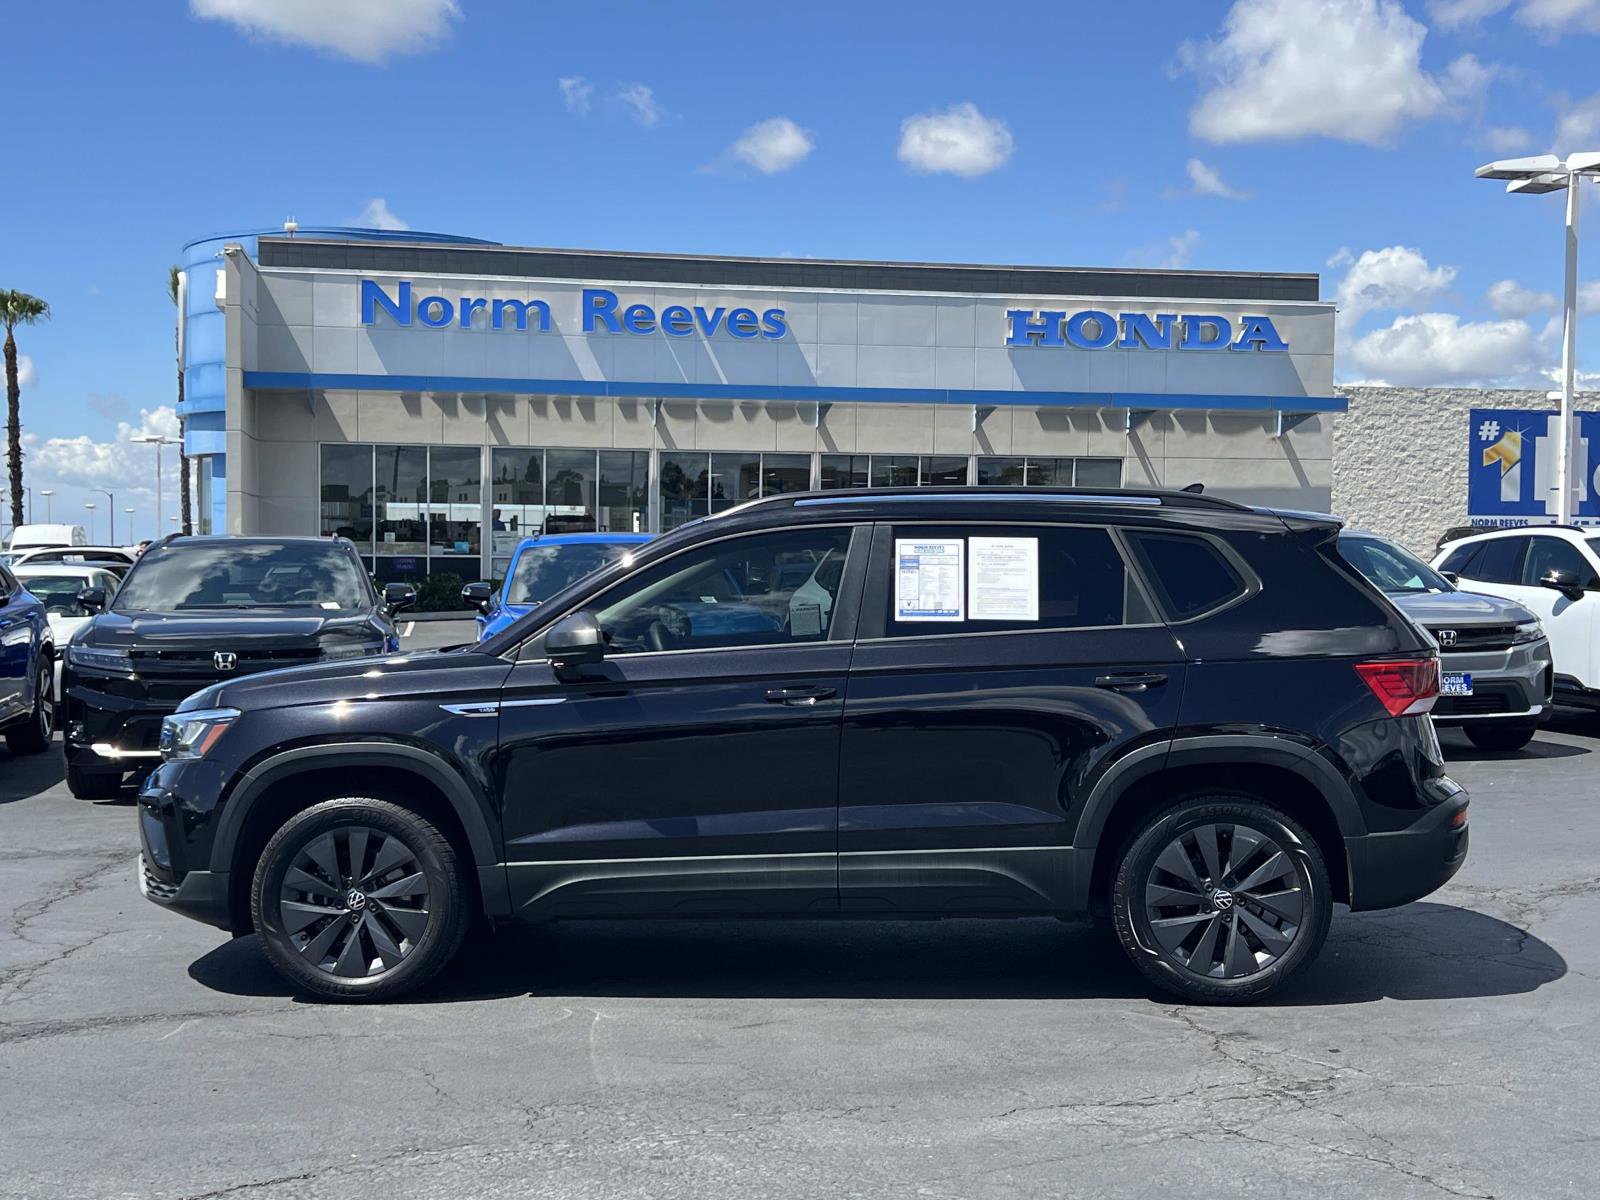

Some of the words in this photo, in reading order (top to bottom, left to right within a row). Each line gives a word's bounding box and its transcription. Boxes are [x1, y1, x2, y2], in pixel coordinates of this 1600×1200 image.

[360, 279, 553, 332] Norm
[582, 288, 787, 340] Reeves
[1004, 309, 1290, 352] HONDA
[1471, 519, 1498, 527] NORM
[1500, 519, 1529, 527] REEVES
[1442, 676, 1464, 684] ORM
